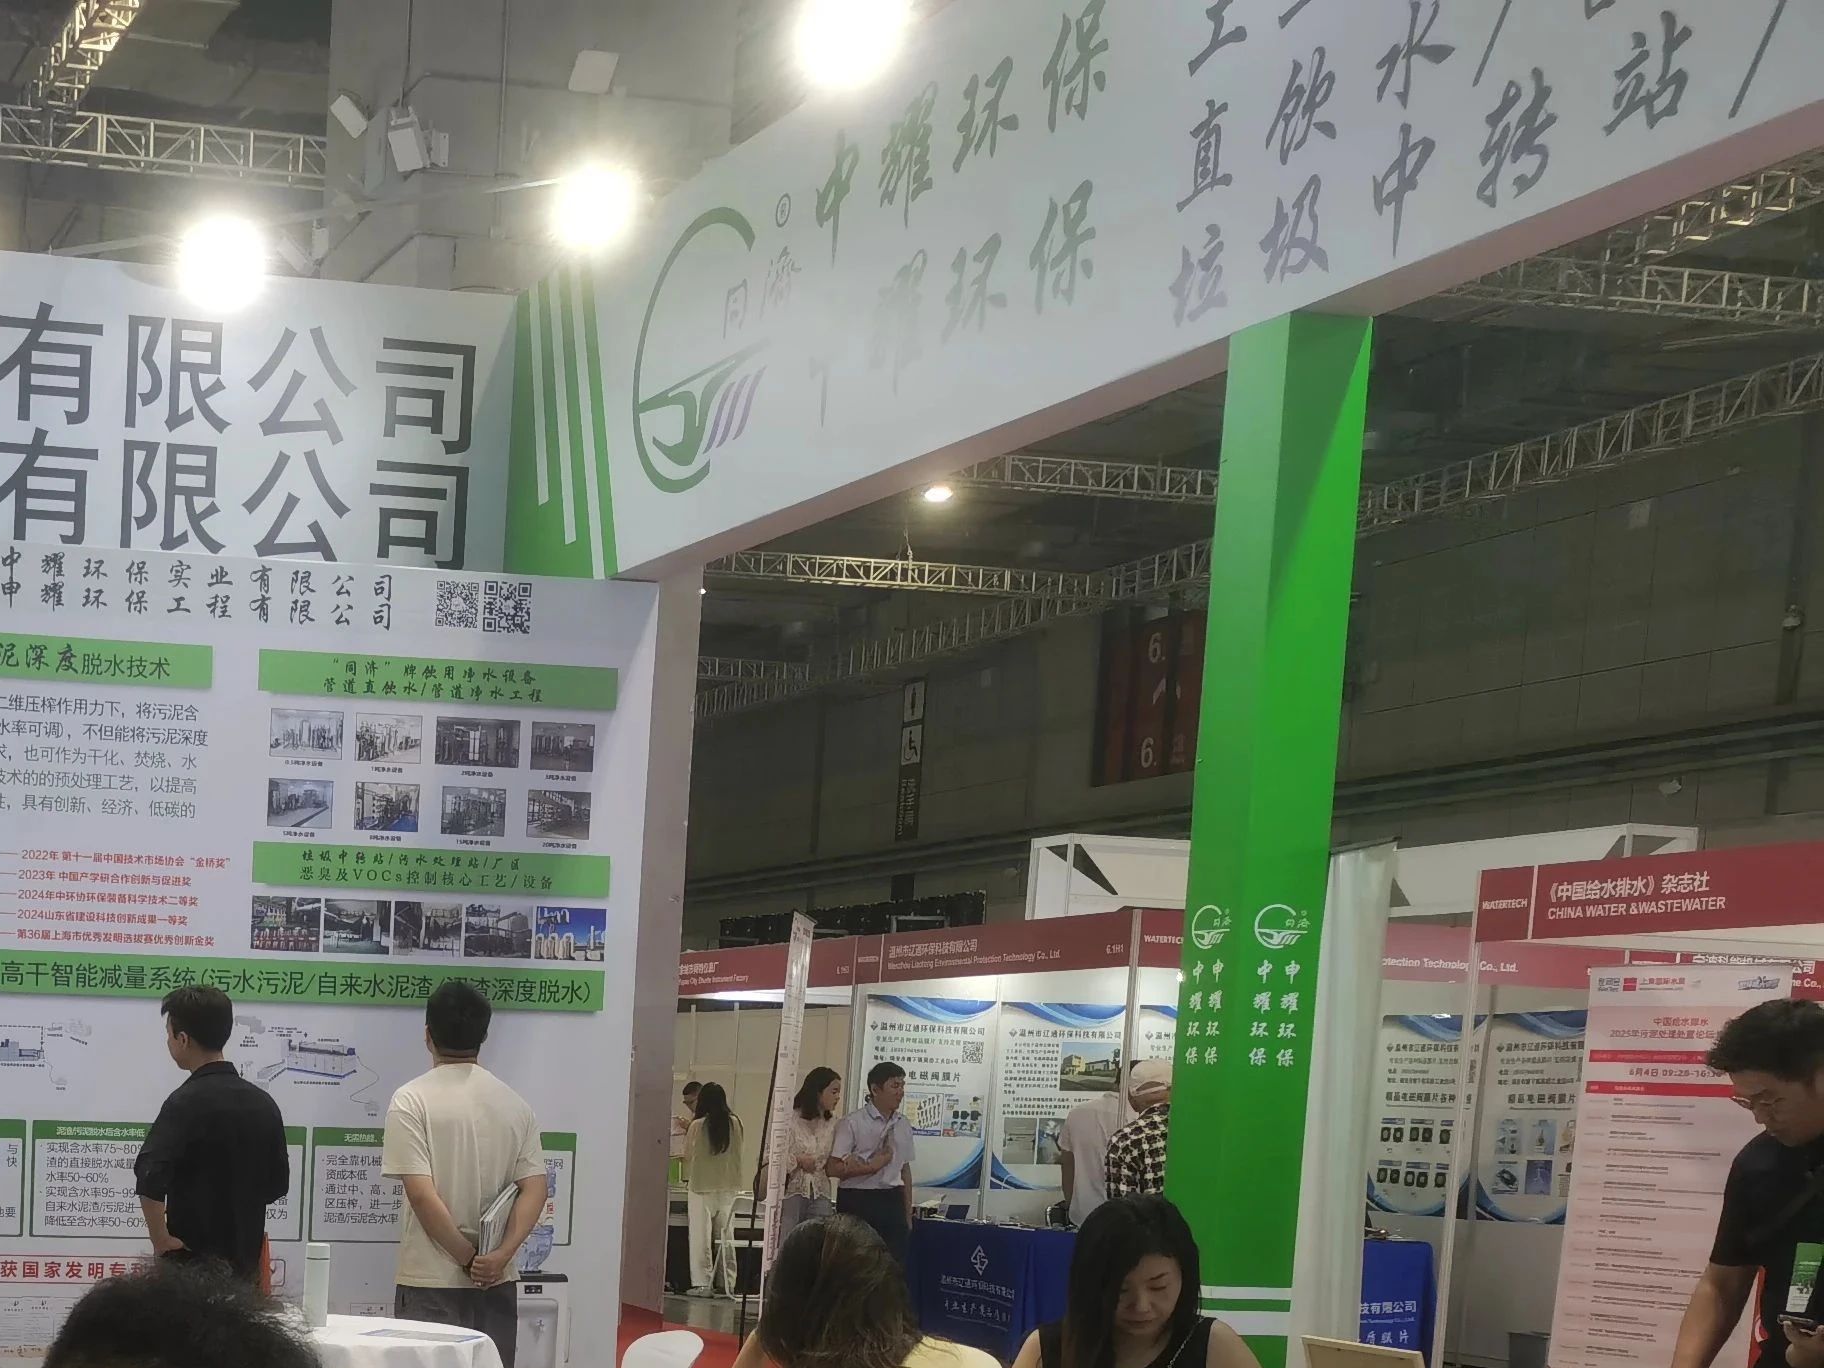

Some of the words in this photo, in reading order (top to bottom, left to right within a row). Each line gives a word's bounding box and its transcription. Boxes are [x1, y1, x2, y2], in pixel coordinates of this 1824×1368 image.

[1482, 898, 1528, 909] WATERTECH
[1548, 904, 1583, 920] CHINA
[1586, 902, 1627, 918] WATER
[1629, 896, 1726, 916] &WASTEWATER
[1144, 934, 1184, 945] WATERTEC
